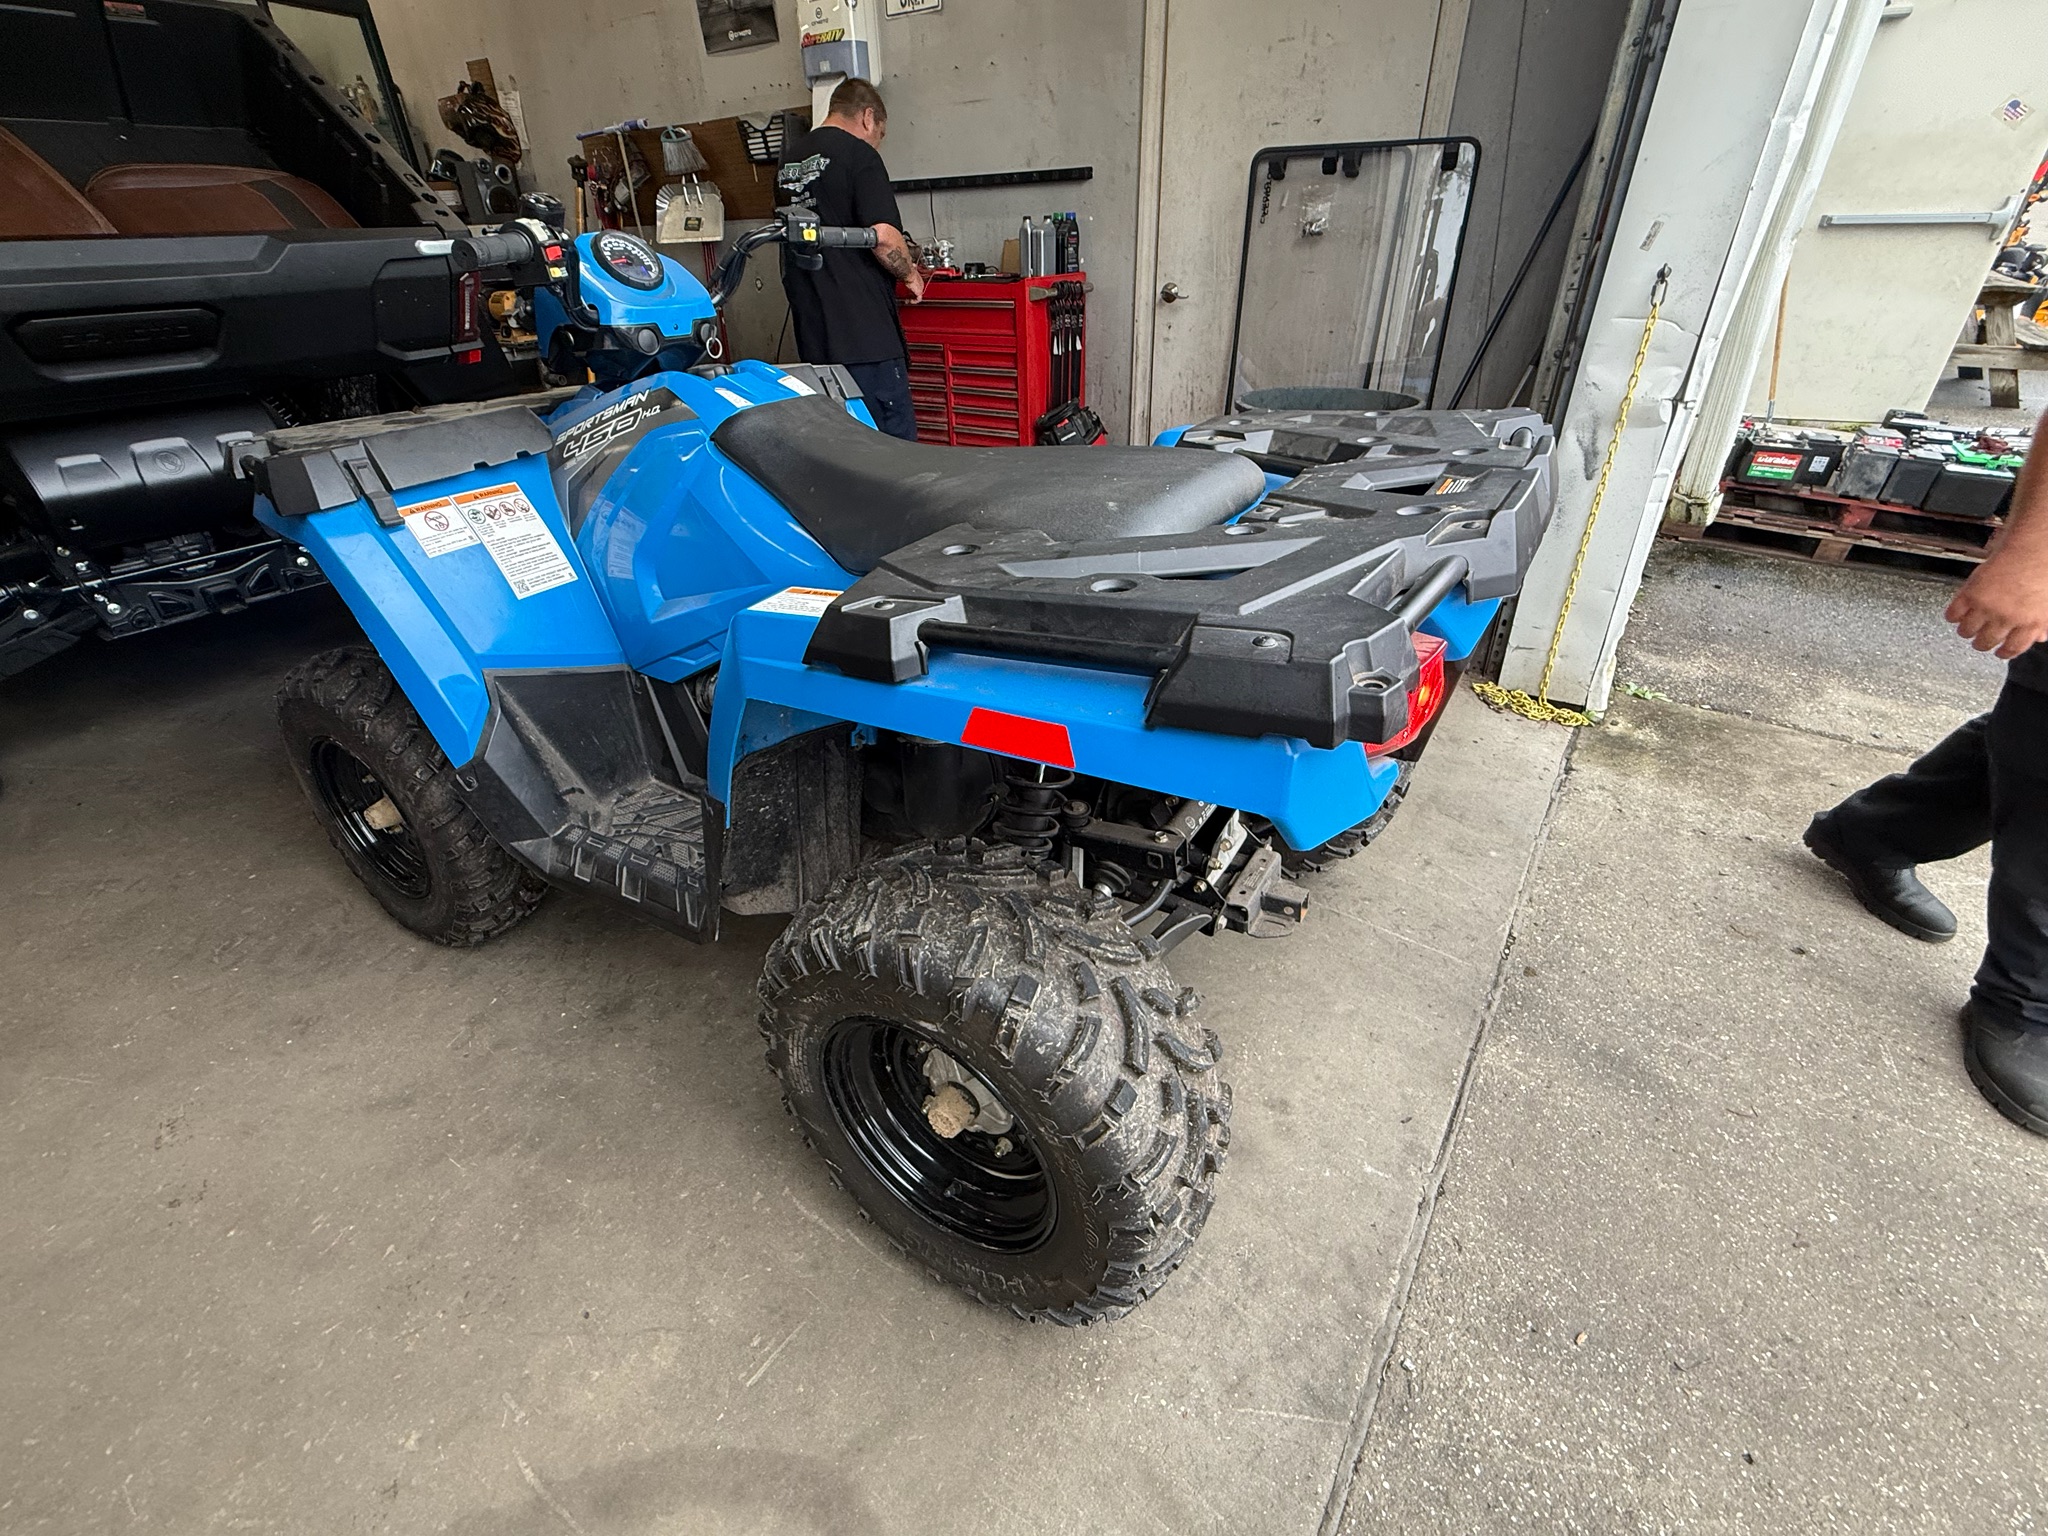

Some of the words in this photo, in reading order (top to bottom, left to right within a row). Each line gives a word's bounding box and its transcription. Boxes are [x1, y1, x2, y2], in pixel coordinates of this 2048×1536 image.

[555, 389, 652, 446] SPORTSMAN
[563, 407, 642, 459] 450
[415, 502, 442, 513] WARNING
